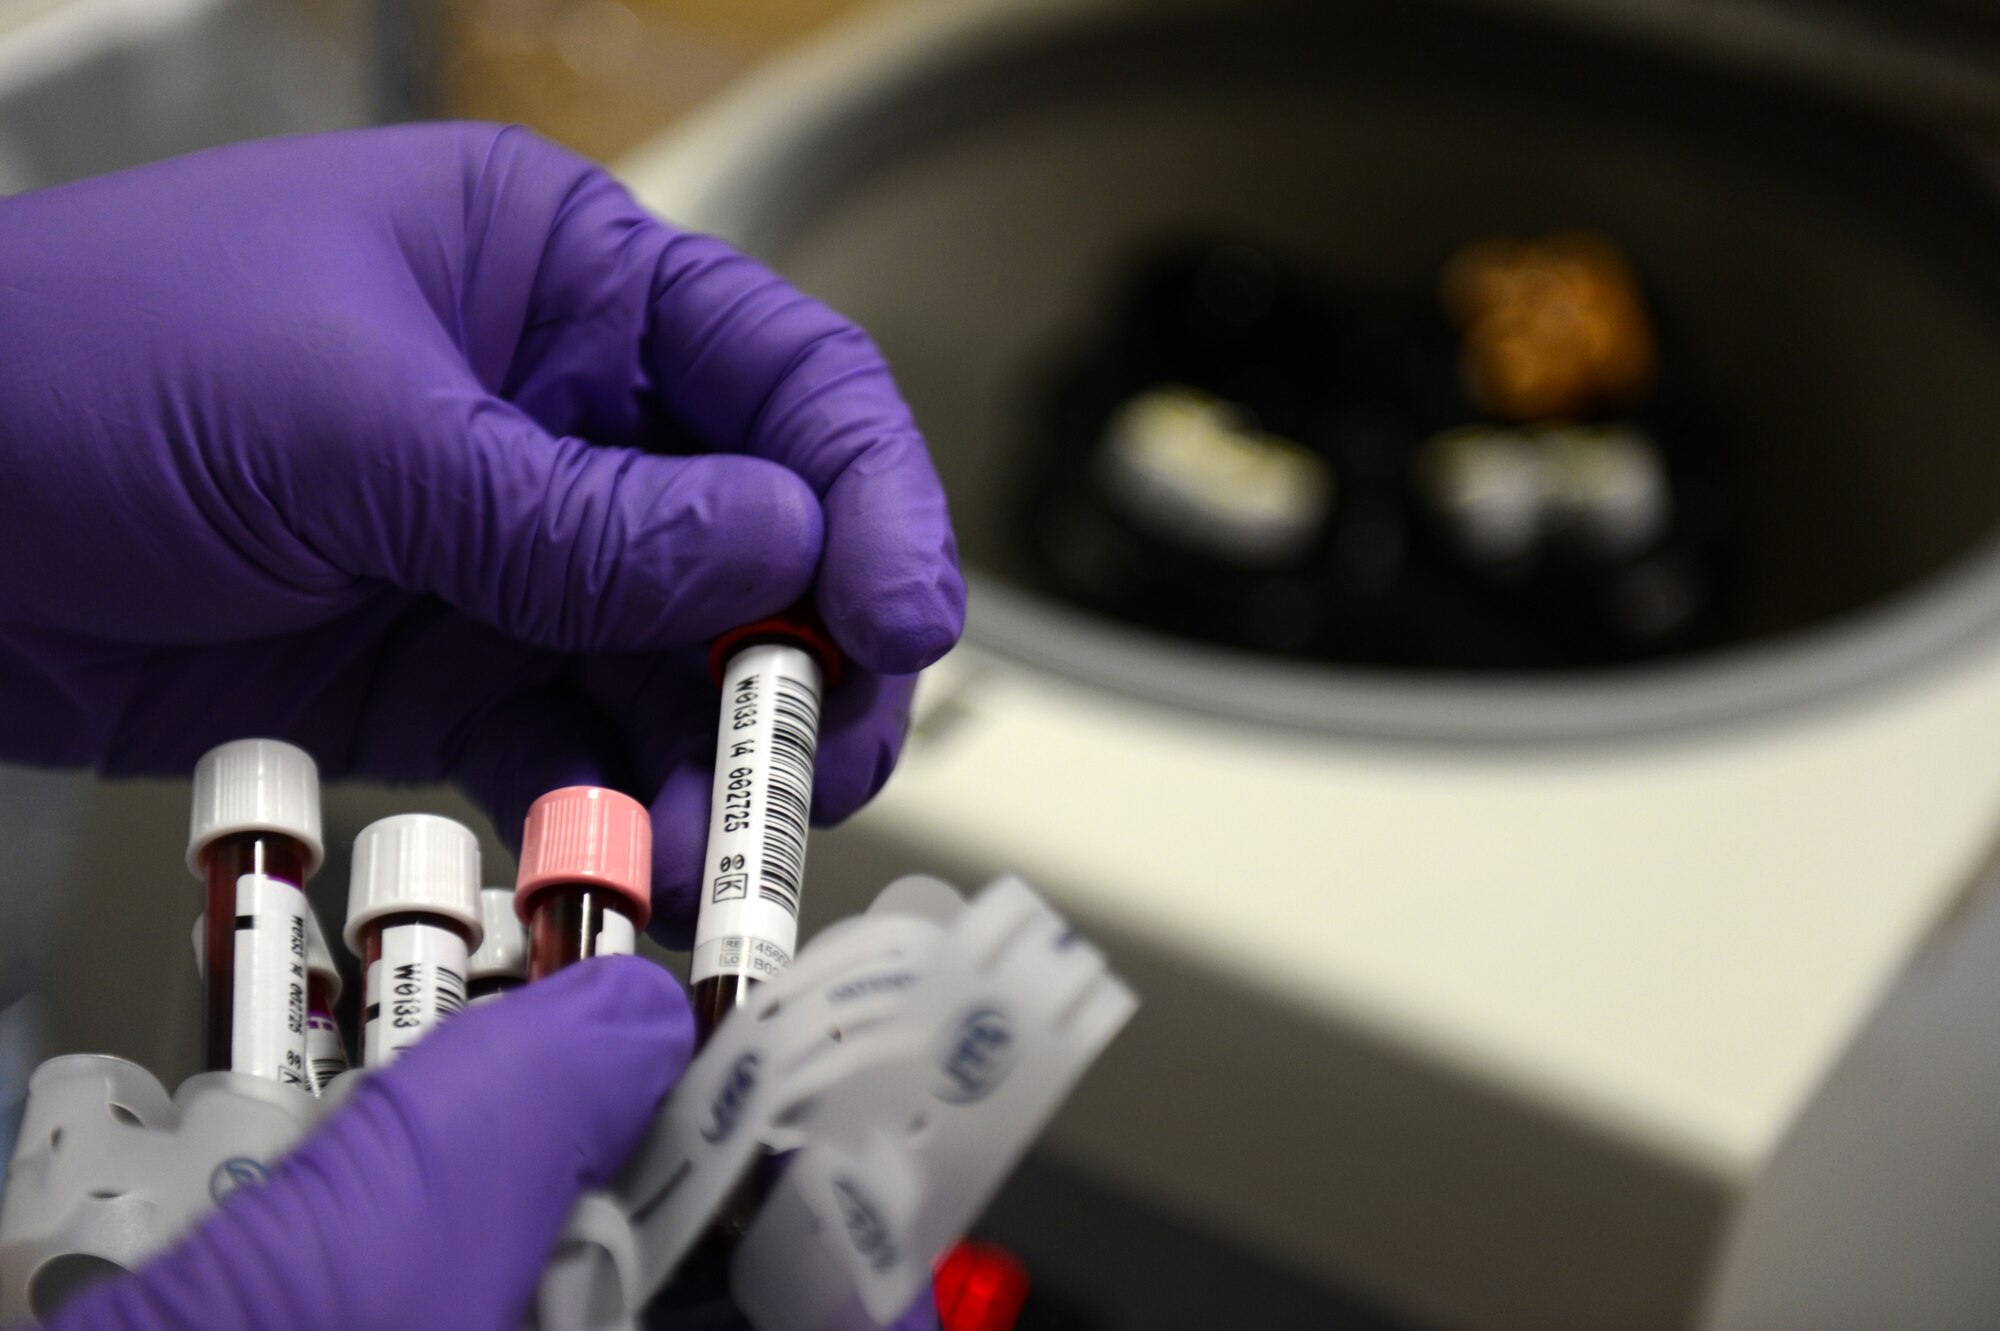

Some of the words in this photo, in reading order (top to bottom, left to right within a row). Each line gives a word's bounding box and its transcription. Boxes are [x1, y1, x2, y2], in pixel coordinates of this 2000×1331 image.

[732, 674, 760, 731] W0133
[730, 739, 756, 759] 14
[723, 767, 753, 833] 002725
[716, 877, 743, 896] K
[392, 962, 421, 1030] W0133
